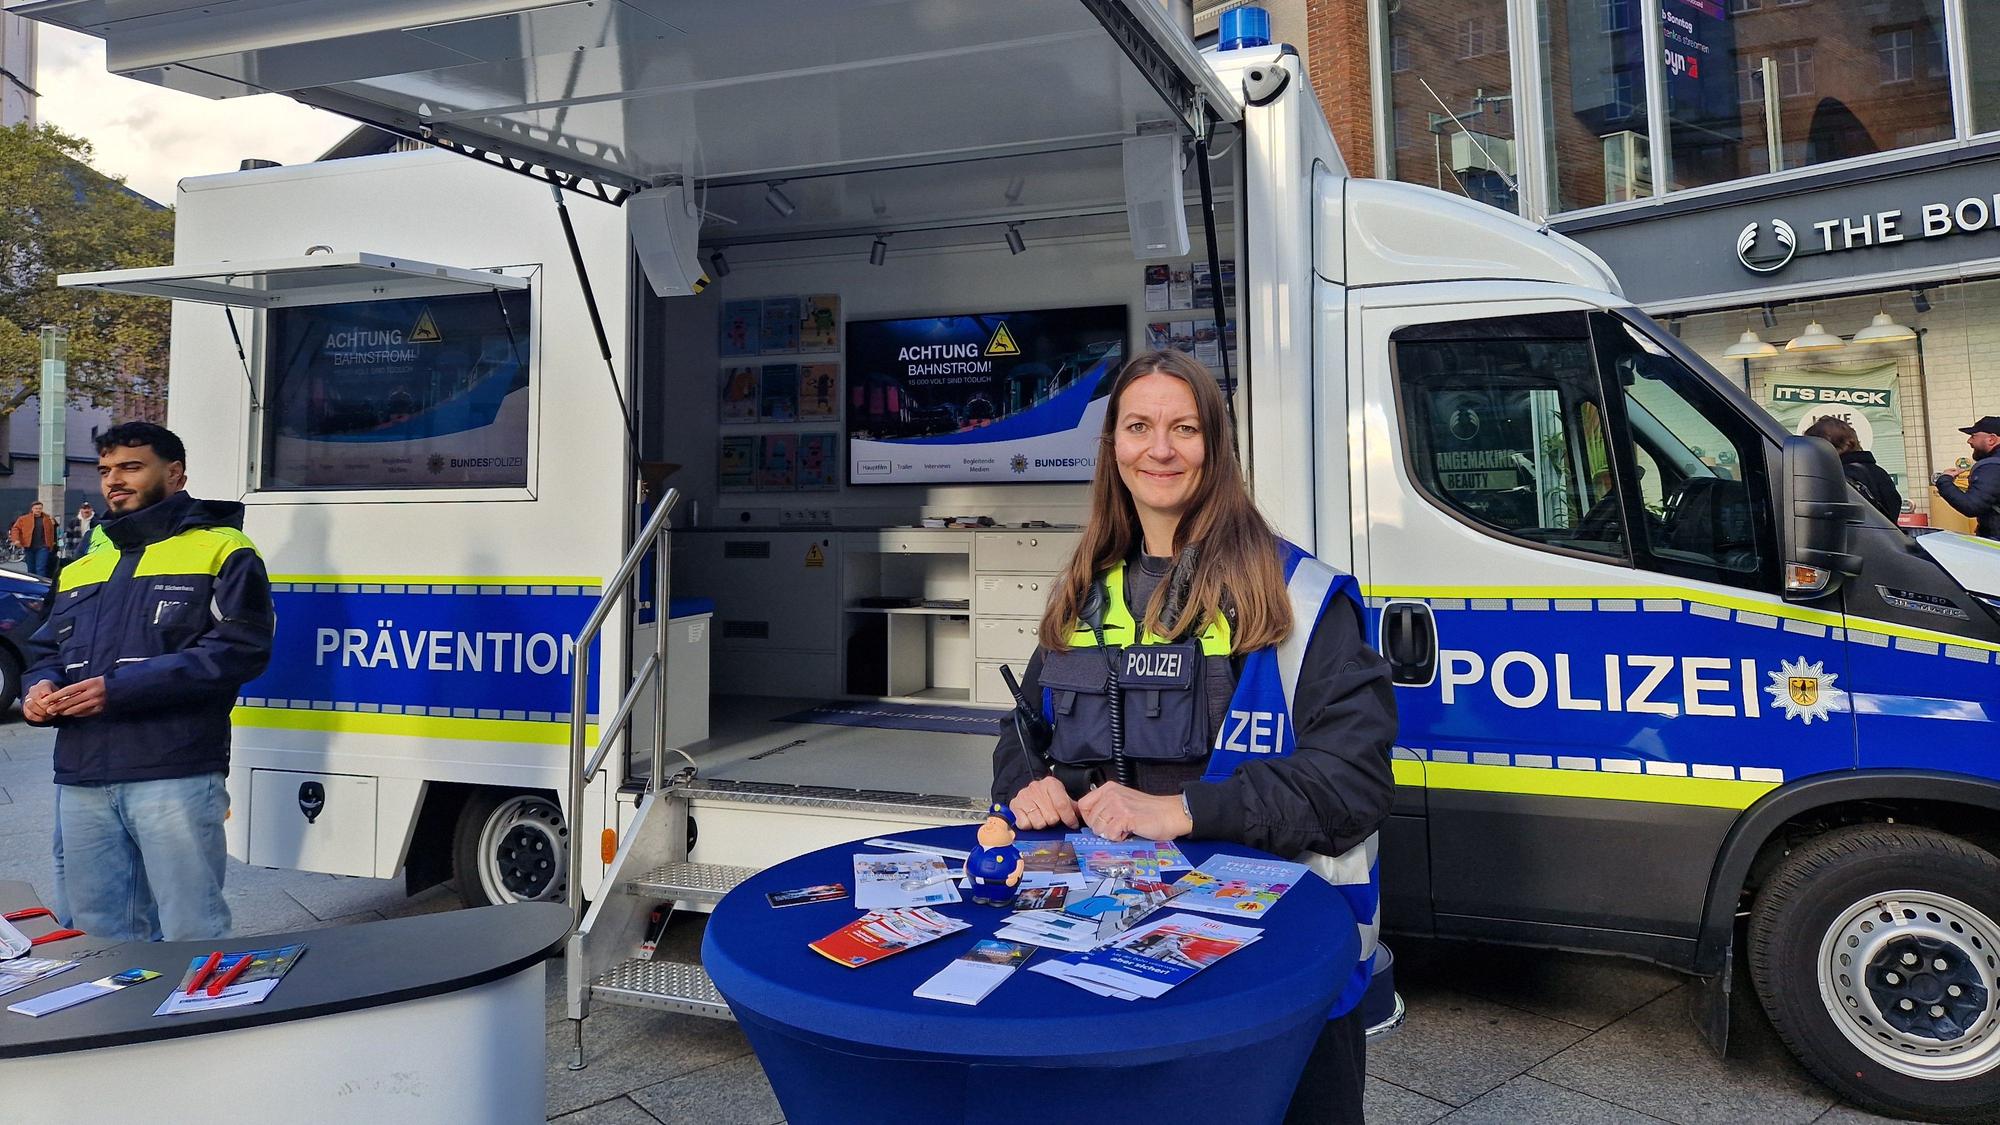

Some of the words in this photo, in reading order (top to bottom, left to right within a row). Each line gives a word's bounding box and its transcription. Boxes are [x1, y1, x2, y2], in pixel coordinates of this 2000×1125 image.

[1667, 12, 1693, 34] Sonntag
[1813, 209, 1904, 251] THE
[326, 329, 402, 349] ACHTUNG
[898, 343, 979, 361] ACHTUNG
[908, 361, 992, 376] BAHNSTROM!
[1776, 387, 1817, 401] IT'S
[1819, 389, 1886, 405] BACK
[450, 456, 524, 469] BUNDESPOLIZEI
[862, 463, 888, 472] Hauptfilm
[897, 463, 913, 471] Trailer
[1448, 472, 1489, 489] BEAUTY
[315, 619, 589, 676] PRÄVENTION
[1126, 652, 1183, 678] POLIZEI
[1441, 649, 1761, 718] POLIZEI
[1110, 956, 1135, 966] aber
